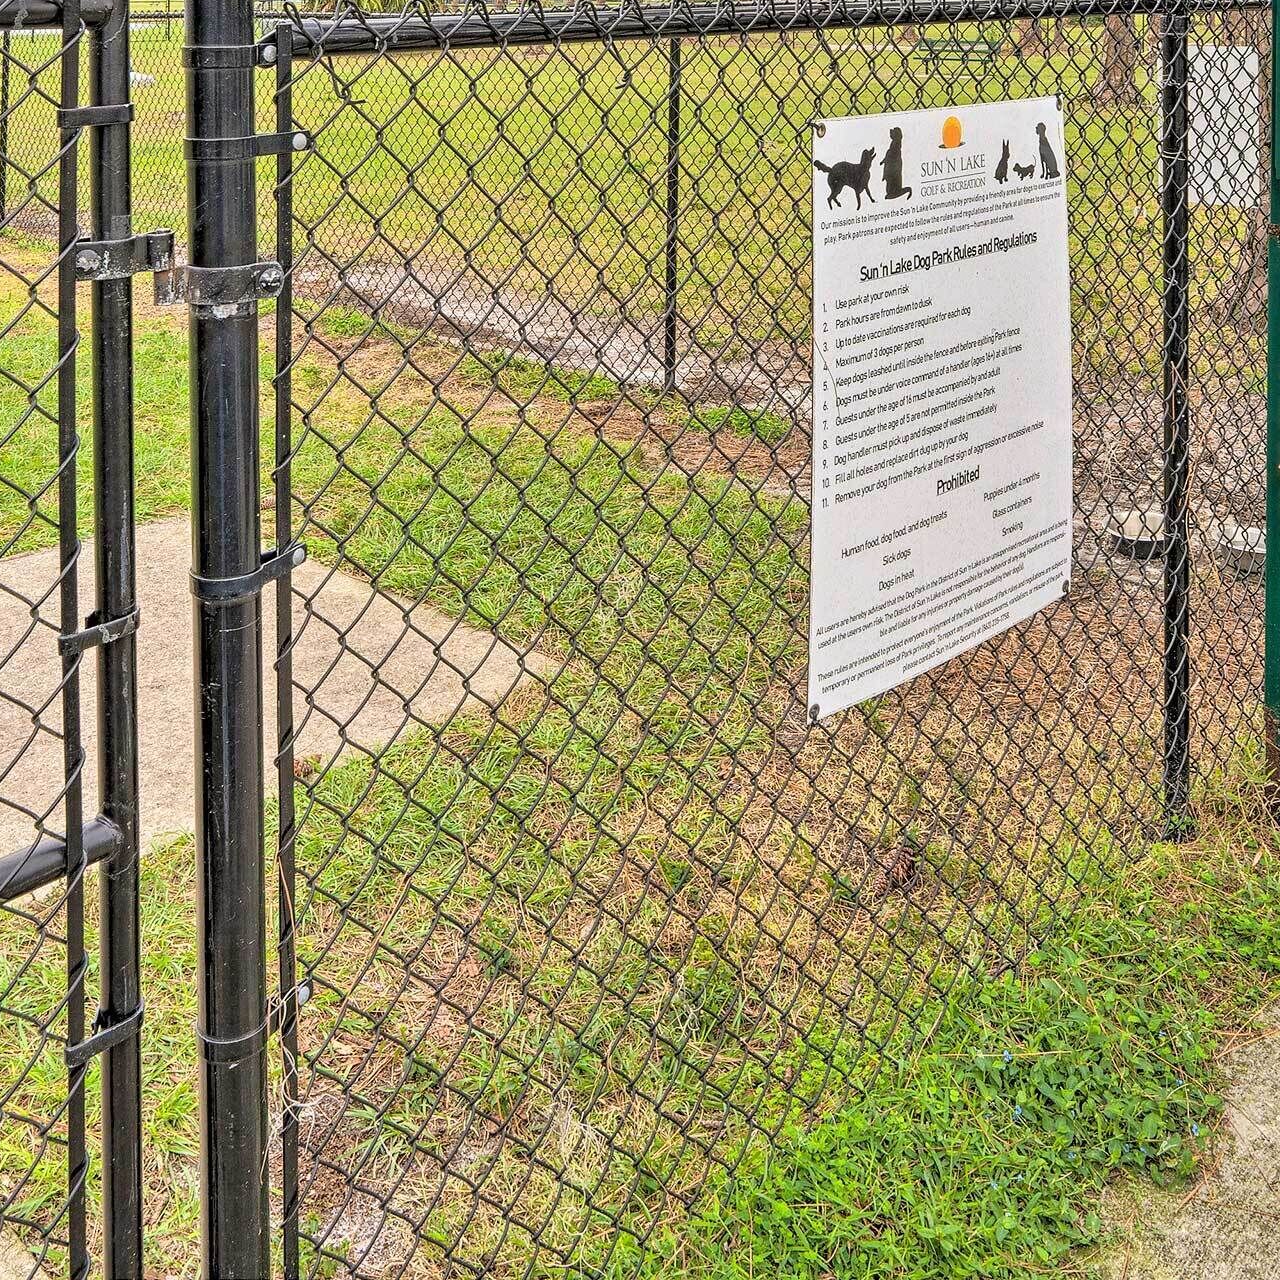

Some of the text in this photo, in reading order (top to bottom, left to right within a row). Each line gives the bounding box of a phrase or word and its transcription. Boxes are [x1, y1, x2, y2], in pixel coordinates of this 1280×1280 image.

[921, 160, 943, 177] SUN
[961, 154, 985, 170] LAKE
[920, 177, 985, 197] GOLF & RECREATION
[820, 222, 831, 230] Our
[832, 218, 854, 227] mission
[856, 216, 860, 224] is
[861, 215, 867, 223] to
[868, 212, 890, 222] improve
[890, 209, 898, 217] the
[900, 208, 909, 216] Sun
[916, 204, 928, 213] Lake
[929, 199, 956, 210] Community
[957, 198, 963, 206] by
[964, 194, 984, 205] providing
[860, 266, 879, 281] Sun
[890, 258, 912, 275] Lake
[913, 255, 930, 270] Dog
[932, 248, 952, 266] Park
[953, 245, 976, 261] Rules
[978, 239, 992, 256] and
[993, 232, 1037, 252] Regulations
[835, 299, 847, 309] Use
[848, 295, 862, 309] park
[863, 293, 869, 303] at
[870, 291, 884, 304] your
[884, 288, 897, 298] own
[897, 284, 909, 295] risk
[835, 317, 850, 329] Park
[851, 314, 869, 325] hours
[870, 312, 880, 321] are
[880, 308, 895, 317] from
[895, 304, 911, 314] dawn
[912, 302, 918, 310] to
[918, 297, 932, 308] dusk
[835, 338, 844, 350] Up
[845, 338, 851, 346] to
[852, 334, 866, 344] date
[867, 324, 903, 340] vaccinations
[904, 322, 914, 331] are
[915, 313, 938, 328] required
[939, 312, 947, 321] for
[947, 308, 960, 319] each
[961, 306, 971, 316] dog
[835, 353, 866, 368] Maximum
[867, 349, 873, 359] of
[874, 348, 878, 358] 3
[878, 346, 893, 356] dogs
[893, 343, 903, 354] per
[904, 338, 924, 351] person
[836, 377, 851, 387] Keep
[852, 372, 867, 383] dogs
[868, 363, 891, 378] leashed
[892, 359, 905, 371] until
[906, 355, 923, 367] inside
[923, 352, 933, 362] the
[934, 349, 949, 359] fence
[949, 343, 959, 354] and
[960, 340, 976, 351] before
[977, 334, 994, 346] exiting
[995, 330, 1006, 341] Park
[1007, 328, 1020, 337] fence
[835, 472, 845, 484] Fill
[846, 470, 855, 481] all
[856, 465, 873, 477] holes
[873, 459, 885, 471] and
[886, 453, 908, 467] replace
[909, 448, 918, 459] dirt
[919, 445, 930, 455] dug
[931, 443, 937, 452] up
[939, 440, 944, 449] by
[946, 435, 957, 447] your
[958, 432, 968, 441] dog
[937, 465, 979, 494] Prohibited
[983, 488, 1003, 501] Puppies
[1004, 481, 1018, 493] under
[1023, 472, 1040, 484] months
[992, 496, 1032, 519] Glass containers
[841, 544, 864, 558] Human
[880, 533, 892, 543] dog
[908, 520, 919, 533] and
[919, 518, 930, 528] dog
[930, 511, 947, 523] treats
[1002, 522, 1023, 536] Smoking
[883, 548, 911, 566] Sick dogs
[878, 569, 914, 591] Dogs in heat
[822, 677, 850, 693] temporary
[857, 661, 884, 680] permanent
[885, 657, 895, 667] loss
